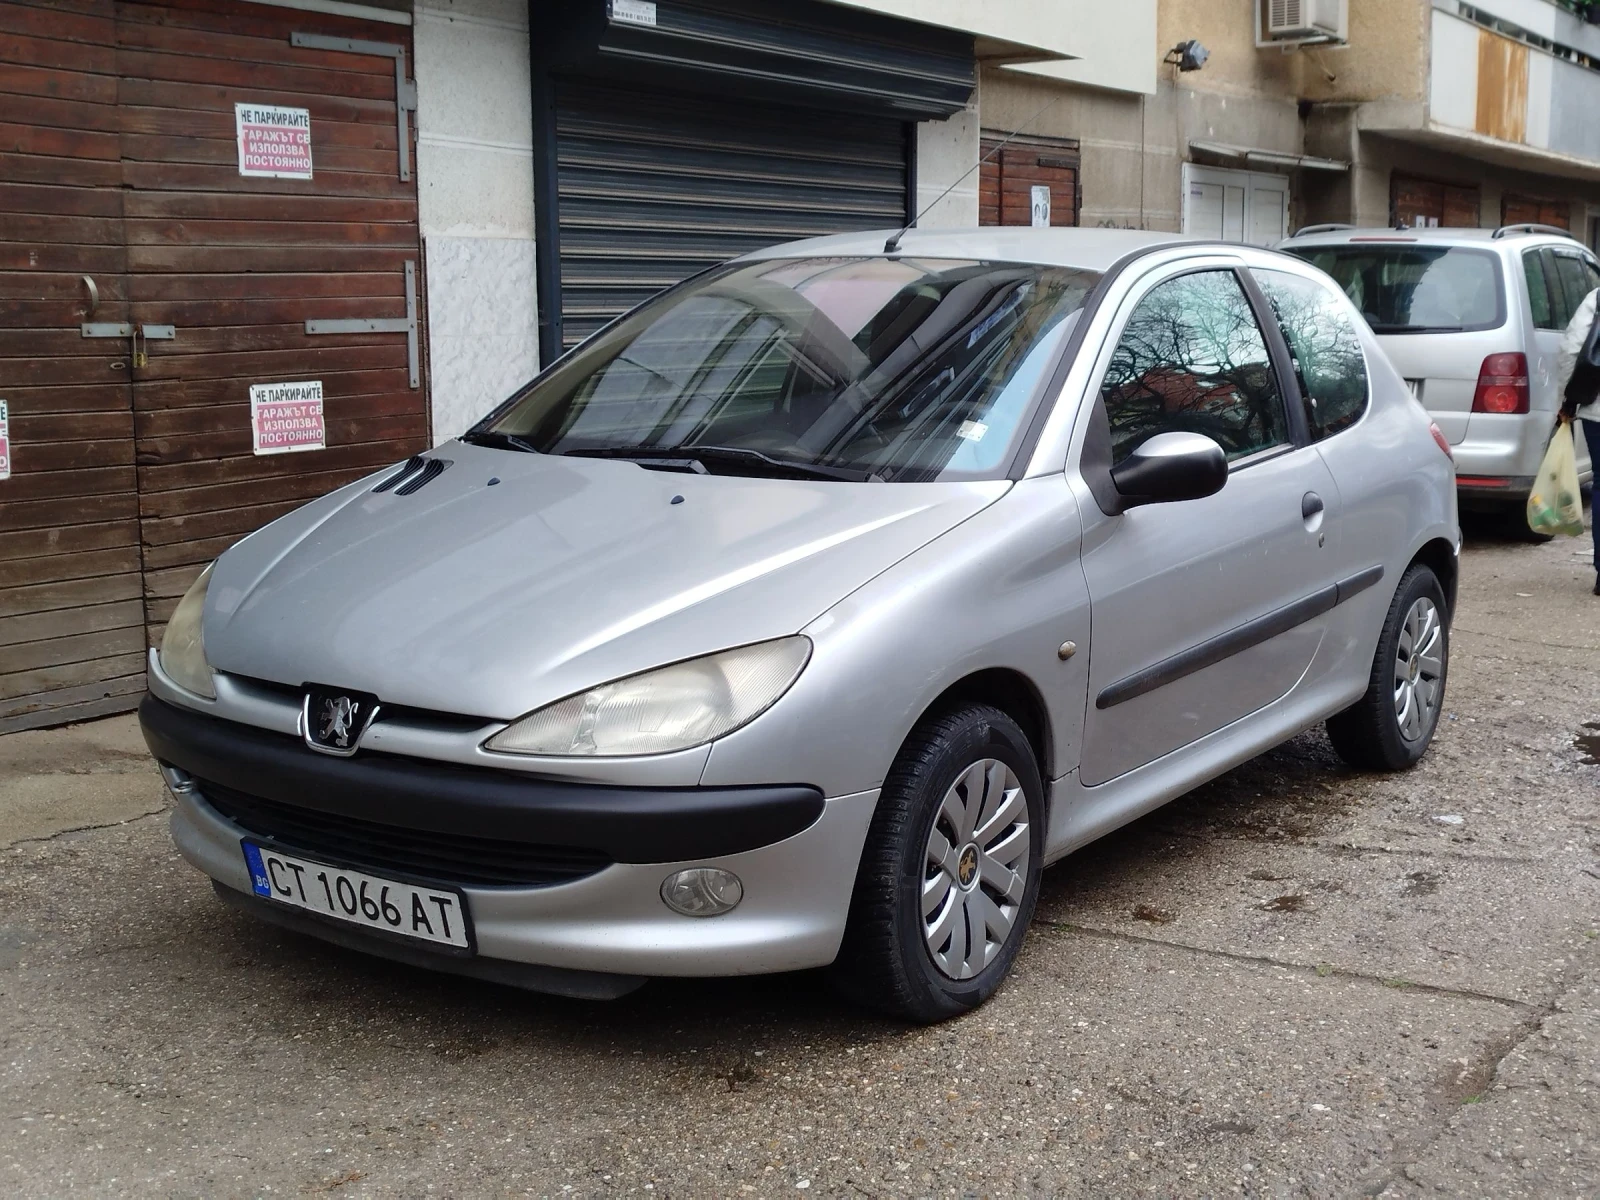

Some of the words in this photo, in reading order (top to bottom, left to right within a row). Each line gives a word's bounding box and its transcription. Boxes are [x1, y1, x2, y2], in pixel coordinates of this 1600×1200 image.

[241, 109, 252, 123] НЕ
[254, 110, 308, 127] ПАРКИРАЙТЕ
[242, 129, 294, 143] ГАРАЖЪТ
[296, 133, 310, 144] СЕ
[249, 142, 305, 156] ИЗПОЛЗВА
[245, 154, 310, 169] ПОСТОЯННО
[256, 389, 267, 403] НЕ
[268, 386, 321, 402] ПАРКИРАЙТЕ
[257, 406, 306, 419] ГАРАЖЪТ
[309, 405, 323, 415] СЕ
[263, 418, 318, 431] ИЗПОЛЗВА
[260, 429, 323, 444] ПОСТОЯННО
[256, 874, 270, 889] BG
[267, 857, 307, 902] CT
[317, 871, 402, 927] 1066
[411, 892, 453, 938] AT
